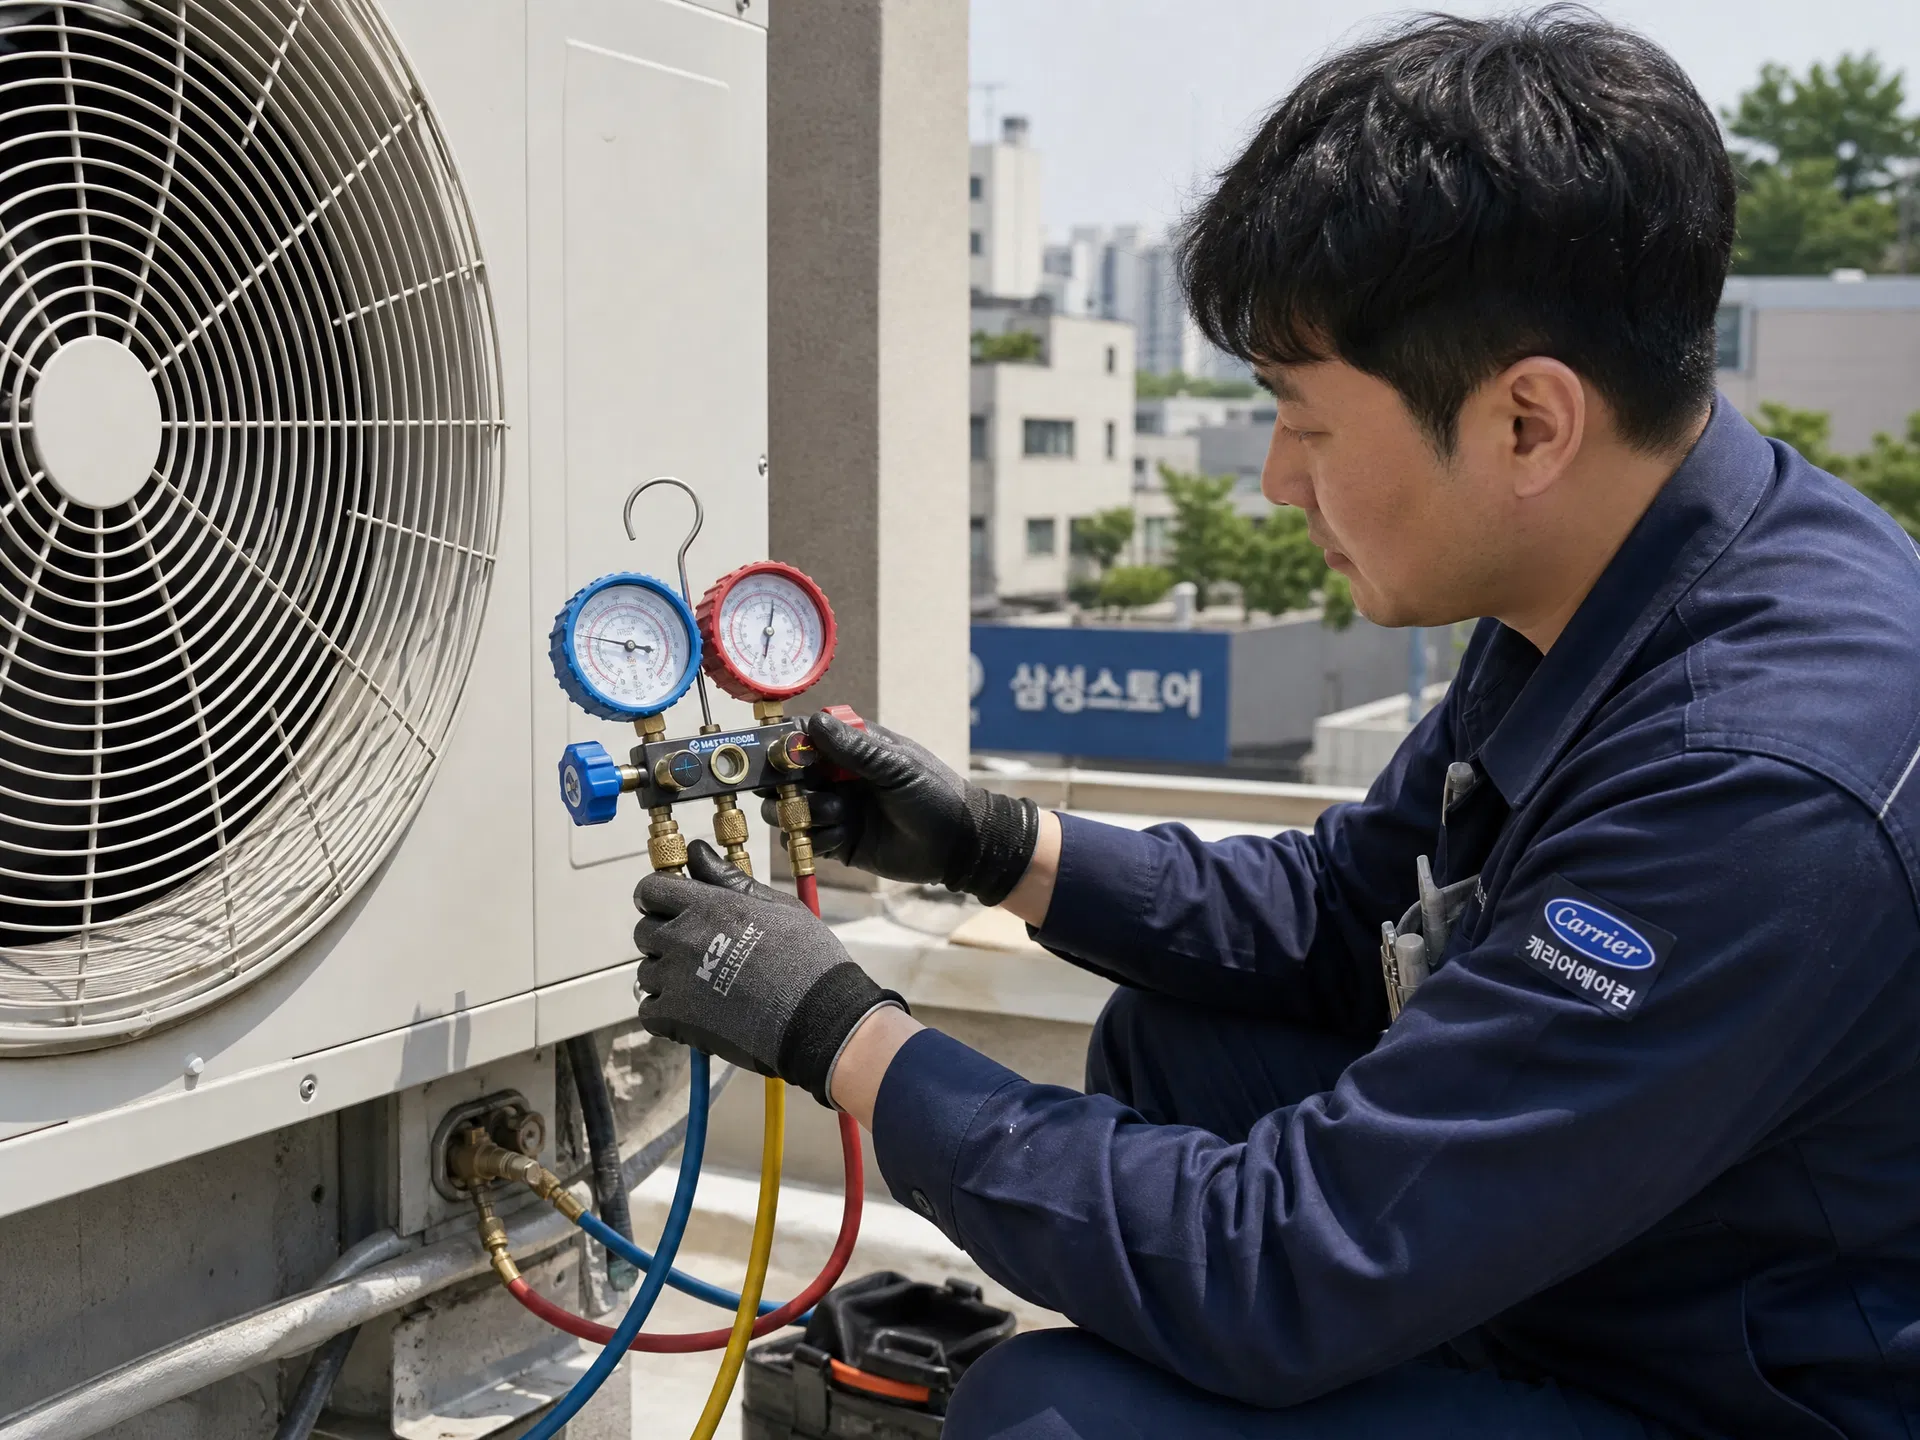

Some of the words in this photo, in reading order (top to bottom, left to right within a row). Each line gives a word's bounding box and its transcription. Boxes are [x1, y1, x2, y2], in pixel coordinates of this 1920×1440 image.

[1010, 663, 1202, 718] 삼성스토어
[696, 933, 732, 982] K2
[1555, 907, 1642, 959] Carrier
[1526, 934, 1636, 1011] 캐리어에어컨
